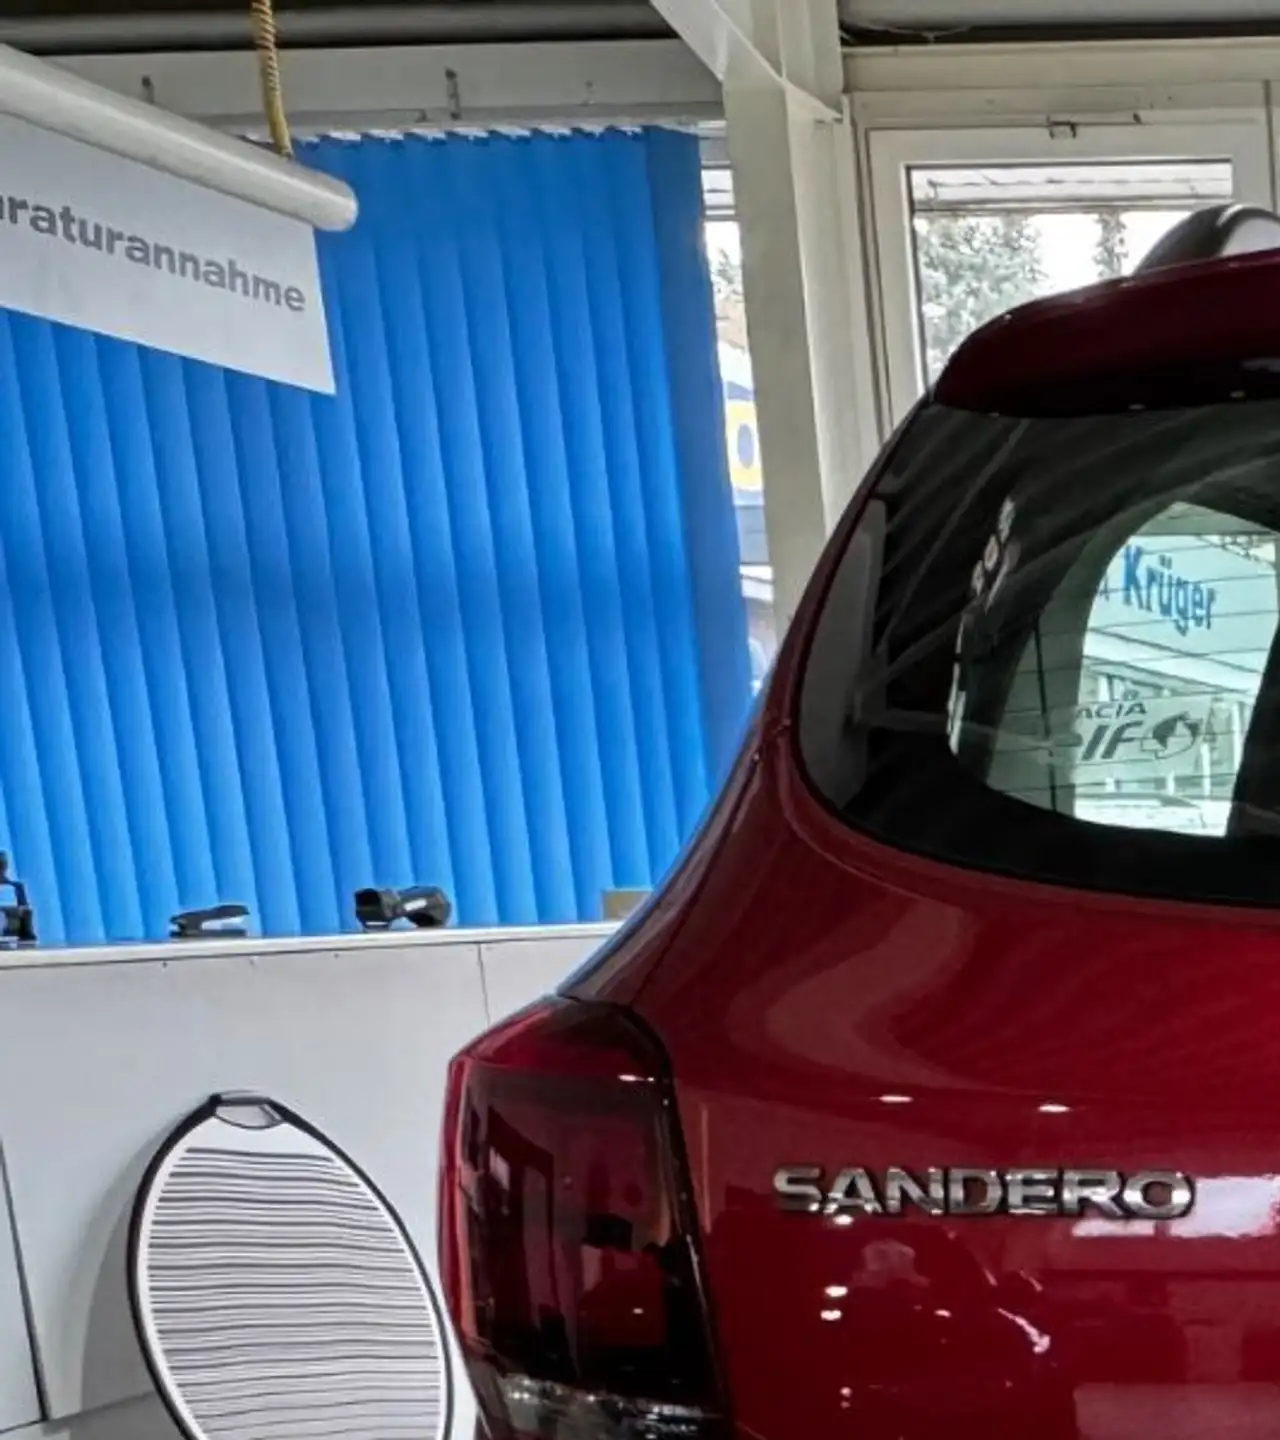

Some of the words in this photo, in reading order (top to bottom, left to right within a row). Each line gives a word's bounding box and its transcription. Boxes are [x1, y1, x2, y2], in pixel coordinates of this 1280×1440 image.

[1122, 545, 1216, 637] Krüger
[1074, 702, 1147, 719] ACIA
[773, 1166, 1195, 1218] SANDERO
